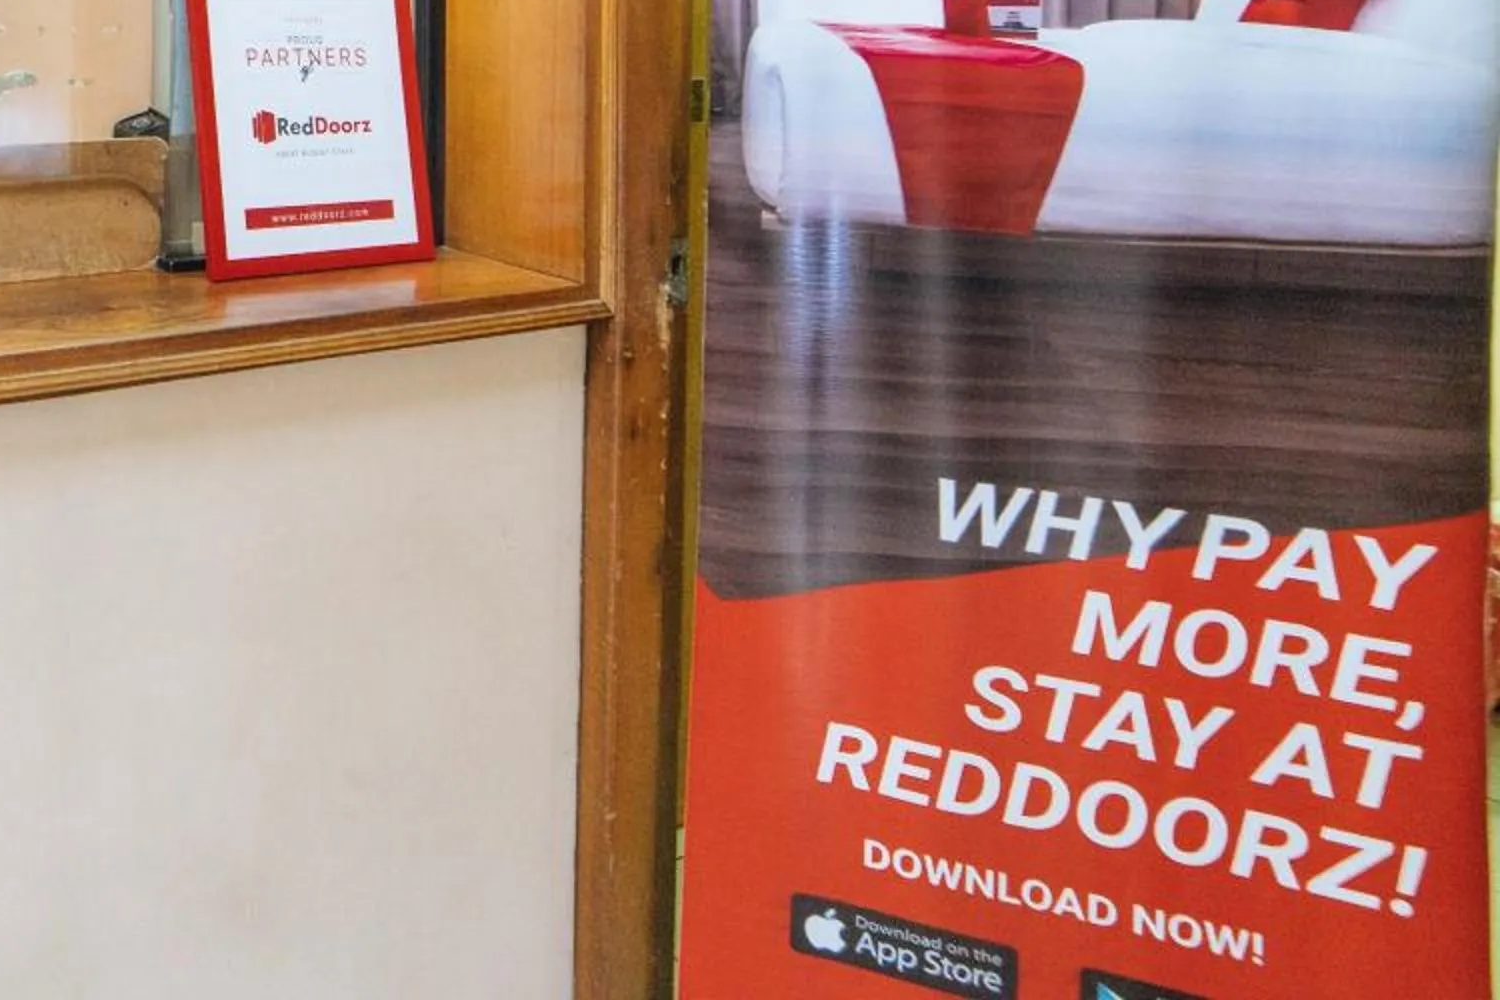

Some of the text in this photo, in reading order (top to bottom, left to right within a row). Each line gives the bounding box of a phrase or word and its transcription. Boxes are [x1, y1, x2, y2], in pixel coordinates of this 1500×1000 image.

[245, 46, 368, 68] PARTNERS
[277, 115, 373, 137] RedDoorz
[271, 208, 369, 224] www.reddoorz.com
[936, 475, 1438, 612] WHY PAY
[1071, 589, 1427, 732] MORE,
[964, 664, 1423, 811] STAY AT
[816, 720, 1428, 920] REDDOORZ!
[854, 914, 1004, 968] Download on the
[862, 838, 1266, 968] DOWNLOAD NOW!
[854, 931, 1004, 994] App Store
